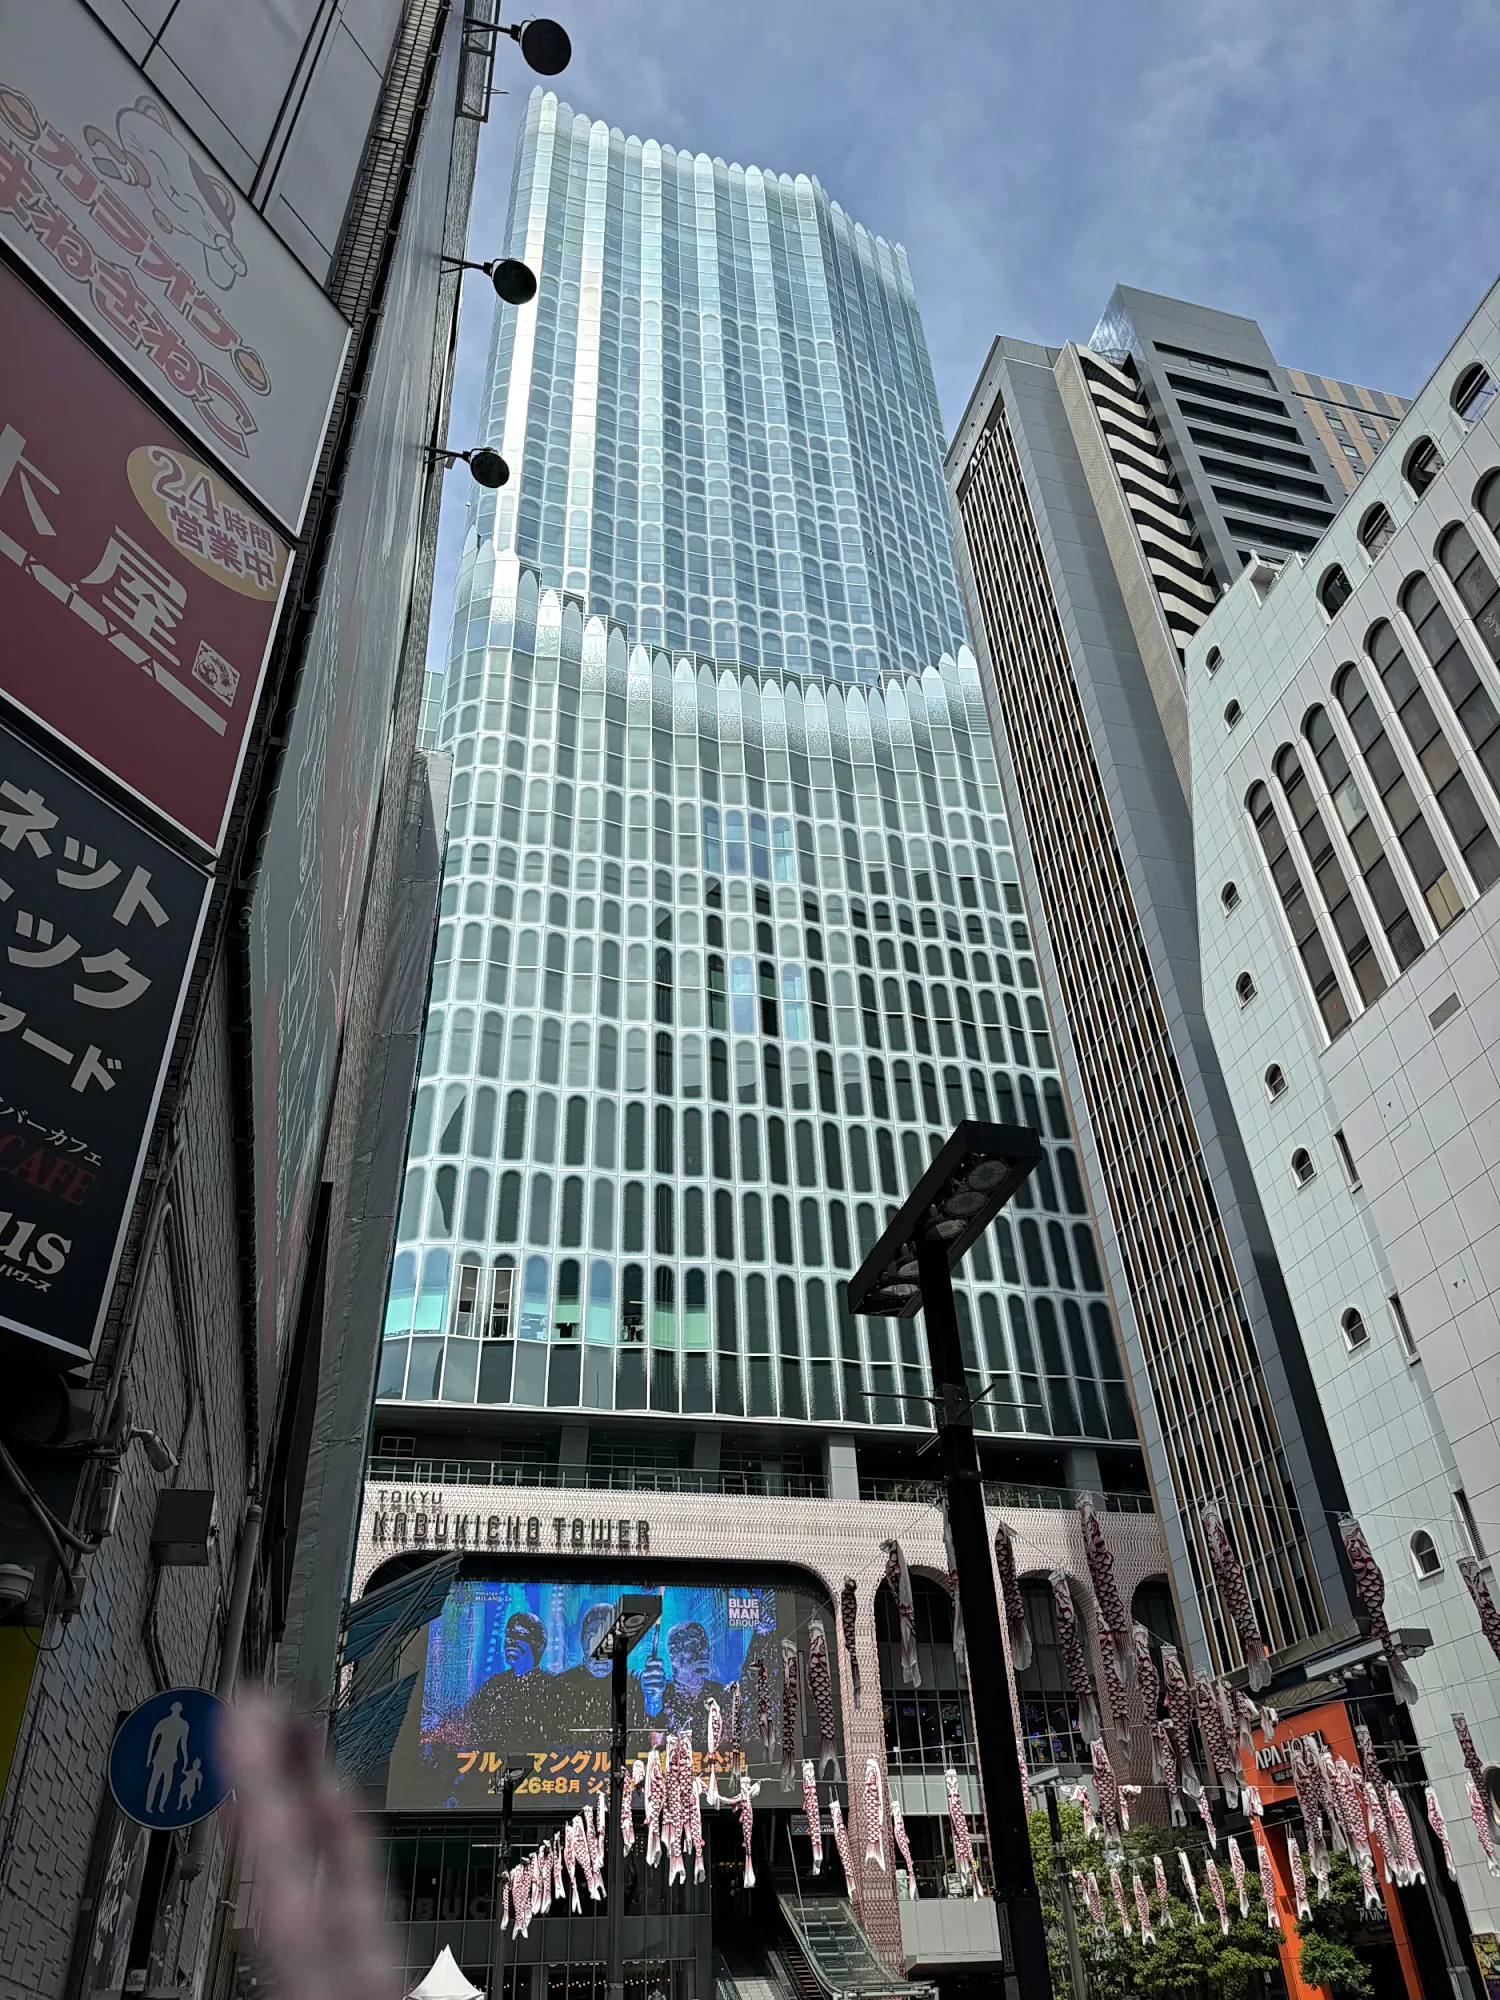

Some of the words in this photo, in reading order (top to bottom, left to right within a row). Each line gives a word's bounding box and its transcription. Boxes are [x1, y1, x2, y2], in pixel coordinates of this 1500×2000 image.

[30, 121, 242, 351] カラオケ
[0, 139, 258, 458] まねきねこ
[150, 448, 275, 556] 24時間
[169, 505, 274, 588] 営業中
[0, 780, 170, 928] ネット
[0, 878, 152, 1009] ック
[0, 1133, 97, 1206] CAFE
[373, 1512, 541, 1541] KABUKICHO
[553, 1517, 650, 1545] TOWER
[378, 1490, 443, 1505] TOKYU
[729, 1598, 759, 1608] BLUE
[729, 1608, 759, 1619] MAN
[1255, 1745, 1281, 1771] APA
[1281, 1730, 1329, 1762] HOL
